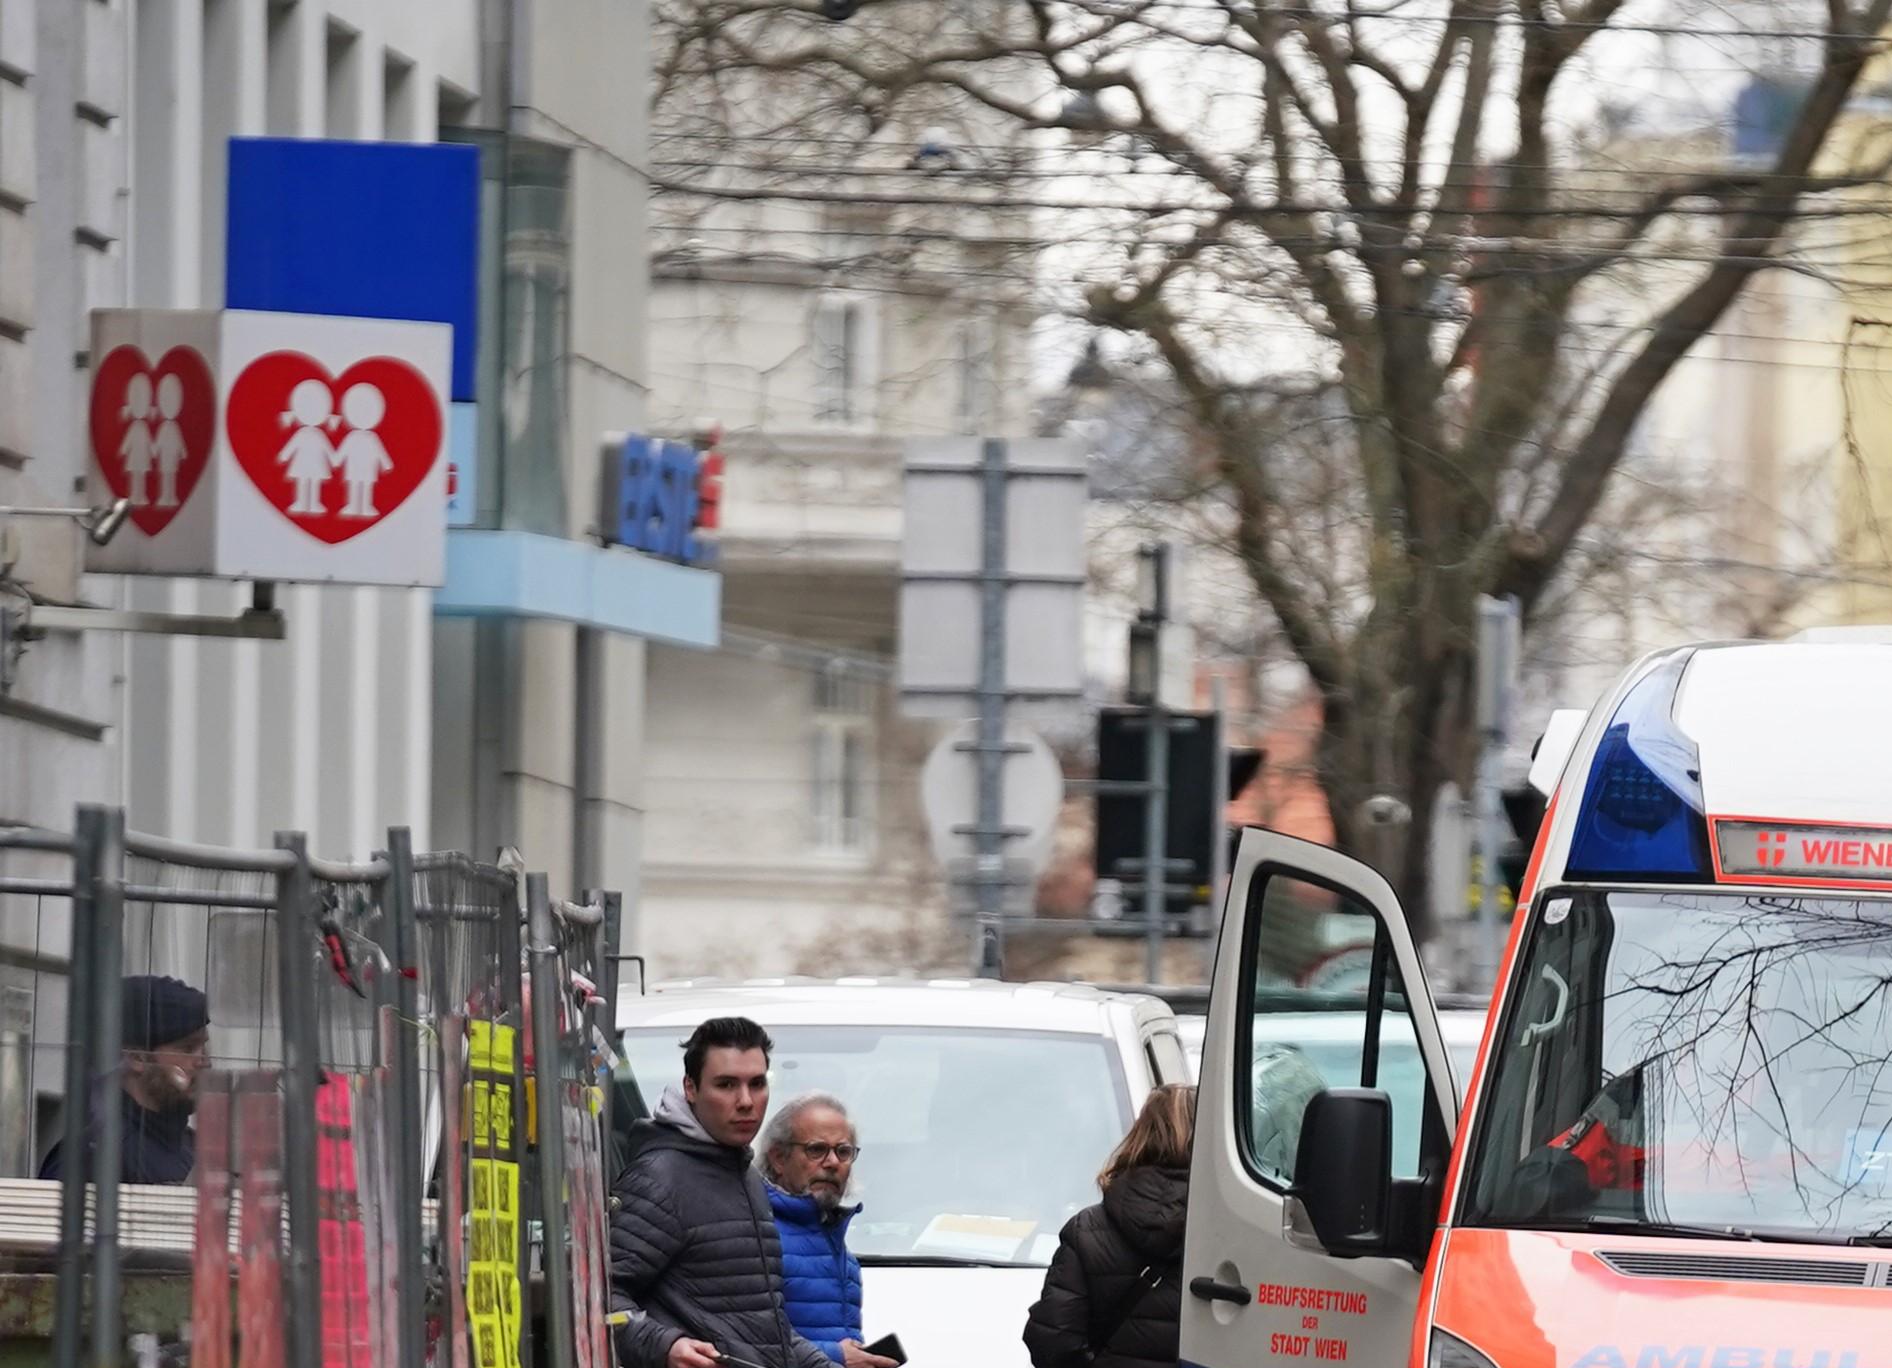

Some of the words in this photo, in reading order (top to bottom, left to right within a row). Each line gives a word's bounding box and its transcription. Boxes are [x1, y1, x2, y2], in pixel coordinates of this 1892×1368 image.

[1258, 1283, 1367, 1315] BERUFSRETTUNG
[1302, 1316, 1318, 1329] DER
[1271, 1333, 1310, 1357] STADT
[1315, 1337, 1347, 1361] WIEN
